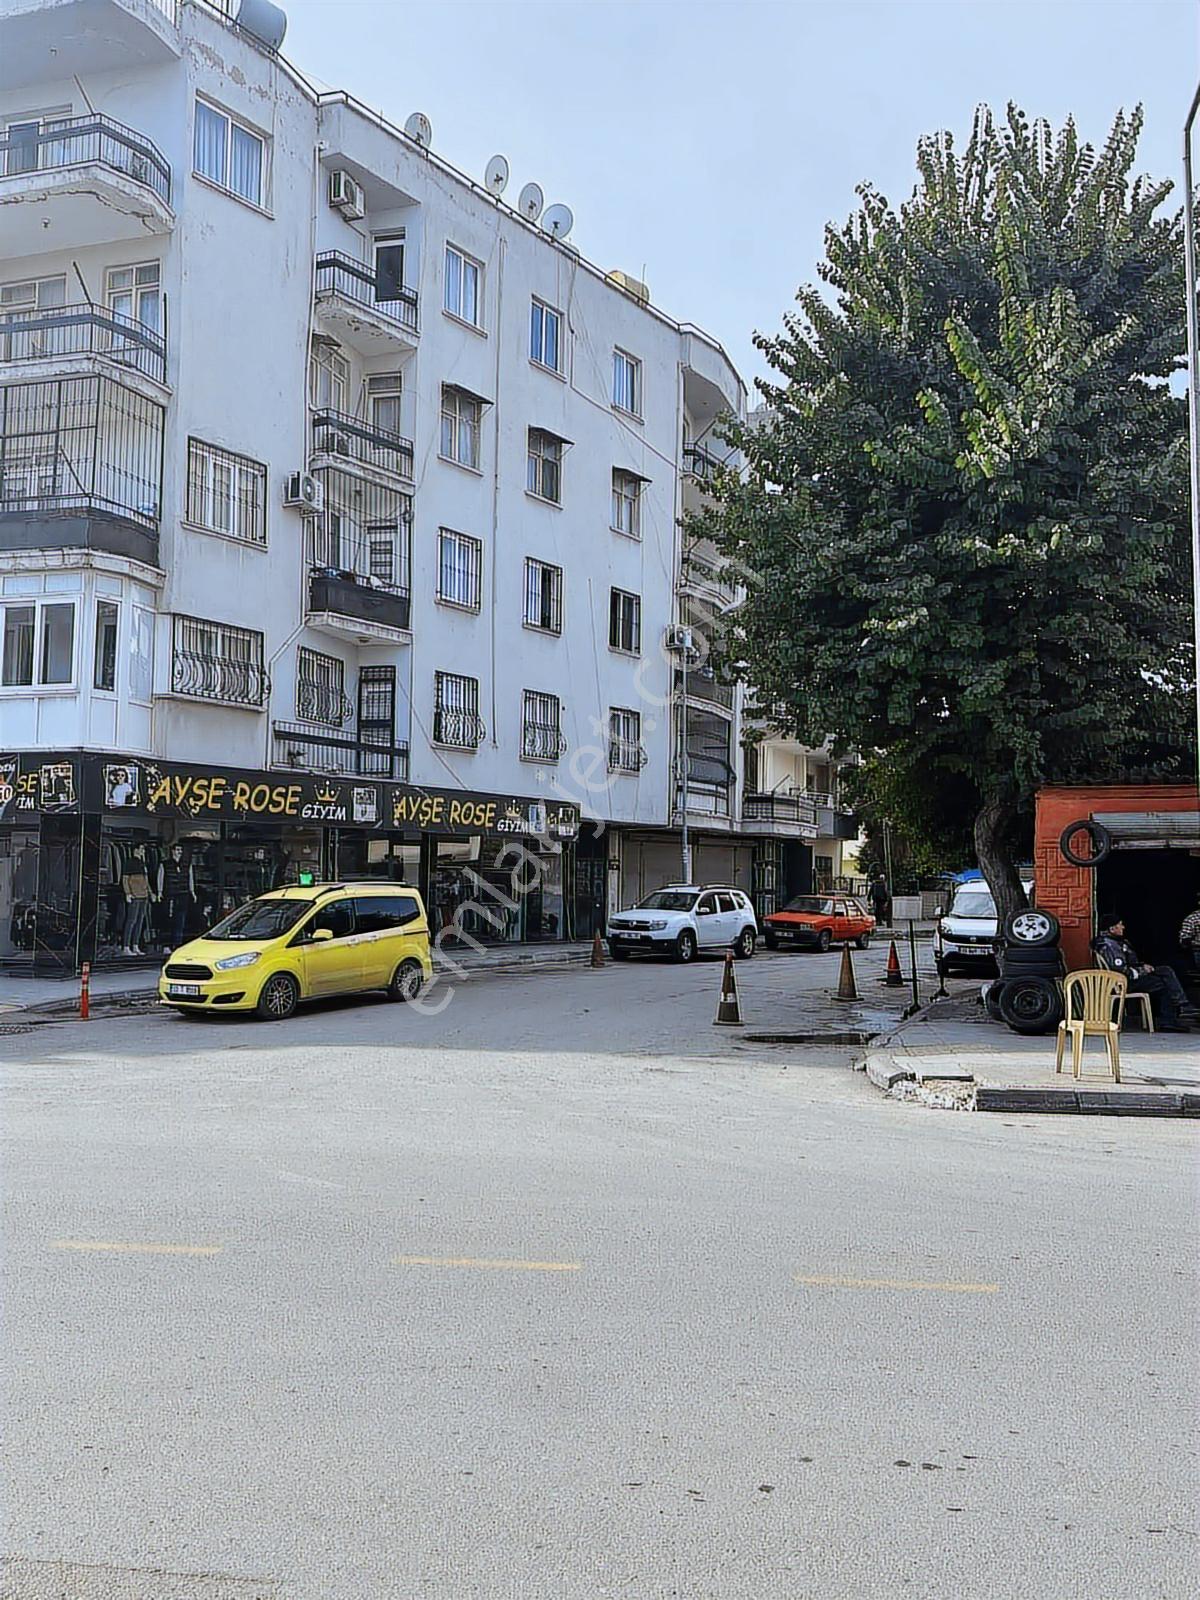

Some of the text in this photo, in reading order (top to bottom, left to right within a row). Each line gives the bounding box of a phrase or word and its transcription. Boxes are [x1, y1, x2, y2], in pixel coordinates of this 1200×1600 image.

[153, 776, 302, 815] AYŞE ROSE
[302, 801, 346, 821] GİYİM
[395, 796, 497, 828] AYŞE ROSE
